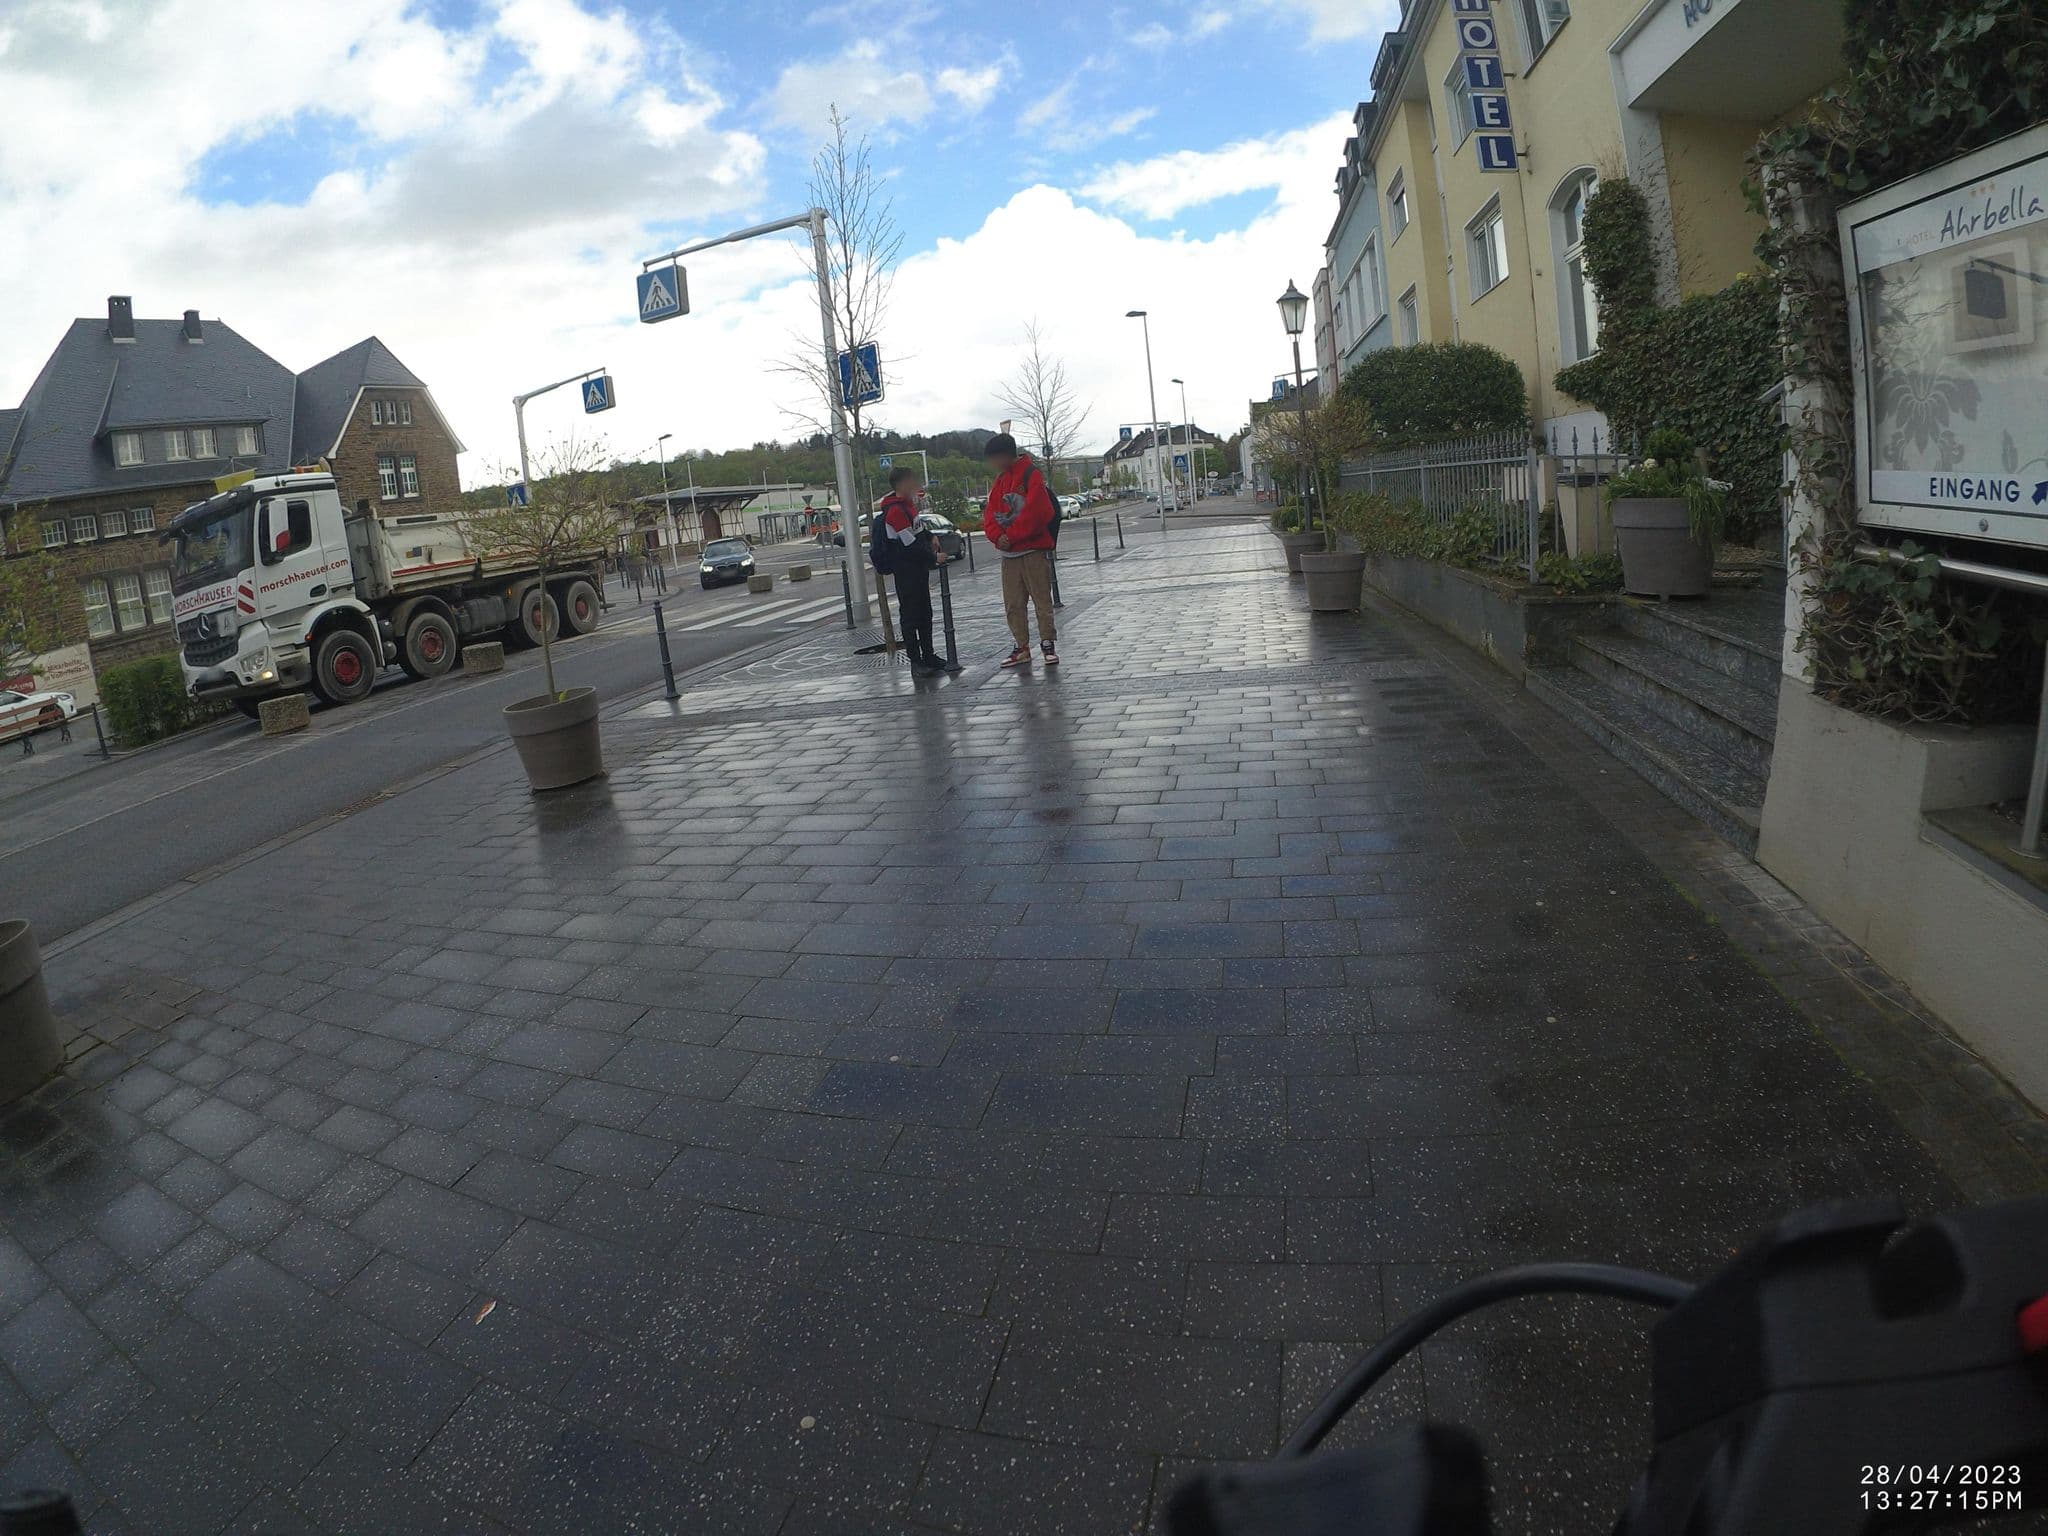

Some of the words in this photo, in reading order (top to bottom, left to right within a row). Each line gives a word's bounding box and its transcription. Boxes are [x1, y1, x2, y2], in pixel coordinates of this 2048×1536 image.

[1940, 185, 2044, 242] Ahrbella
[1930, 477, 2020, 502] EINGANG
[260, 558, 349, 594] morschhaeuser.com
